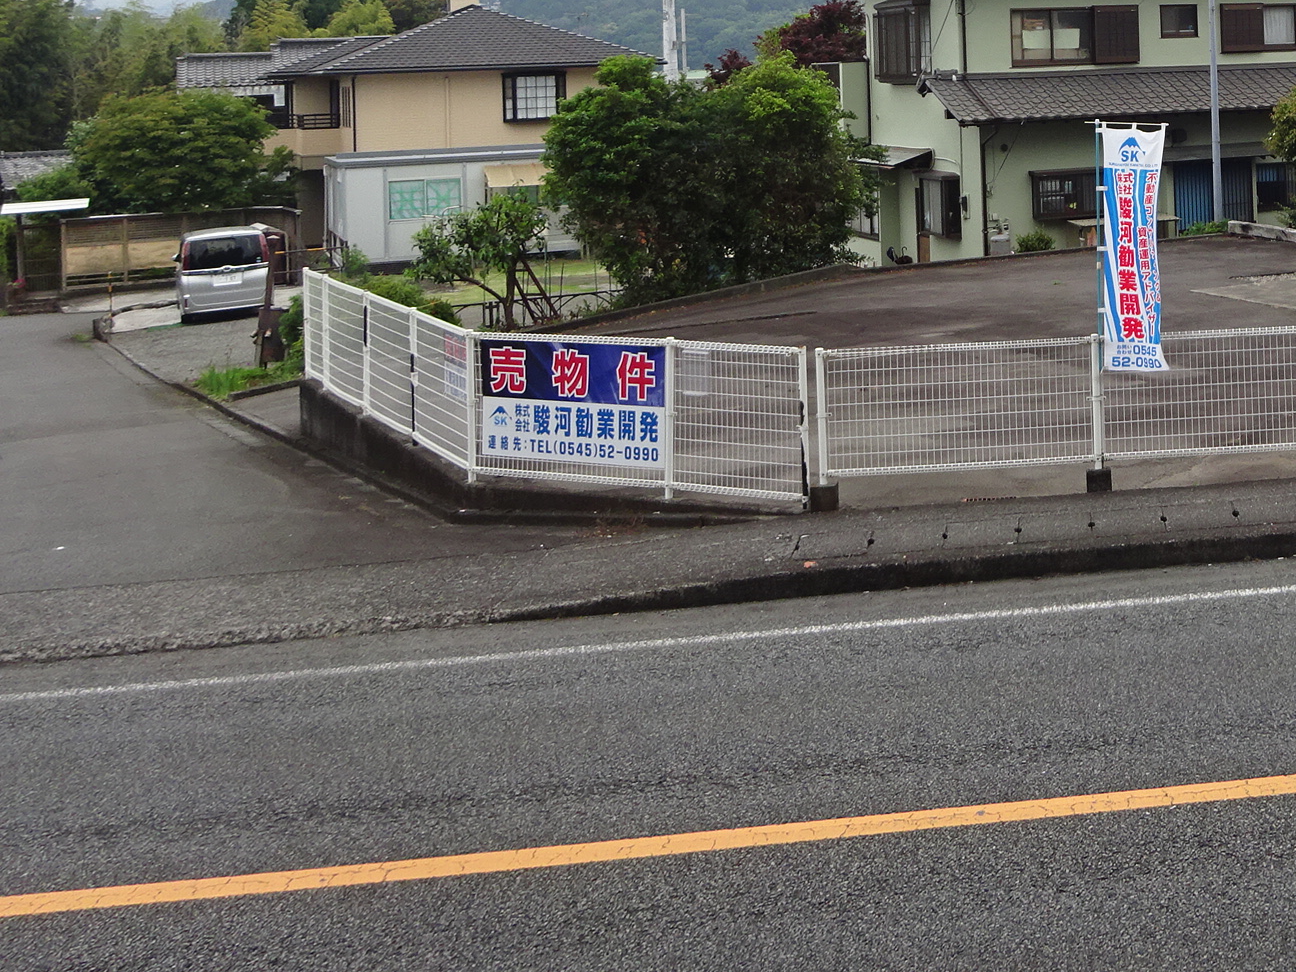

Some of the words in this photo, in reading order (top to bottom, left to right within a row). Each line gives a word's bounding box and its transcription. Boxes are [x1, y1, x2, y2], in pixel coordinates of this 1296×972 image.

[1121, 150, 1139, 163] SK
[1118, 196, 1145, 339] 駿河勧業開発
[1133, 344, 1157, 357] 0545
[1111, 356, 1162, 369] 52-0990
[489, 345, 656, 402] 売物件
[515, 403, 531, 418] 株式
[494, 415, 508, 426] SK
[515, 418, 531, 433] 会社
[532, 404, 659, 443] 駿河勧業開発
